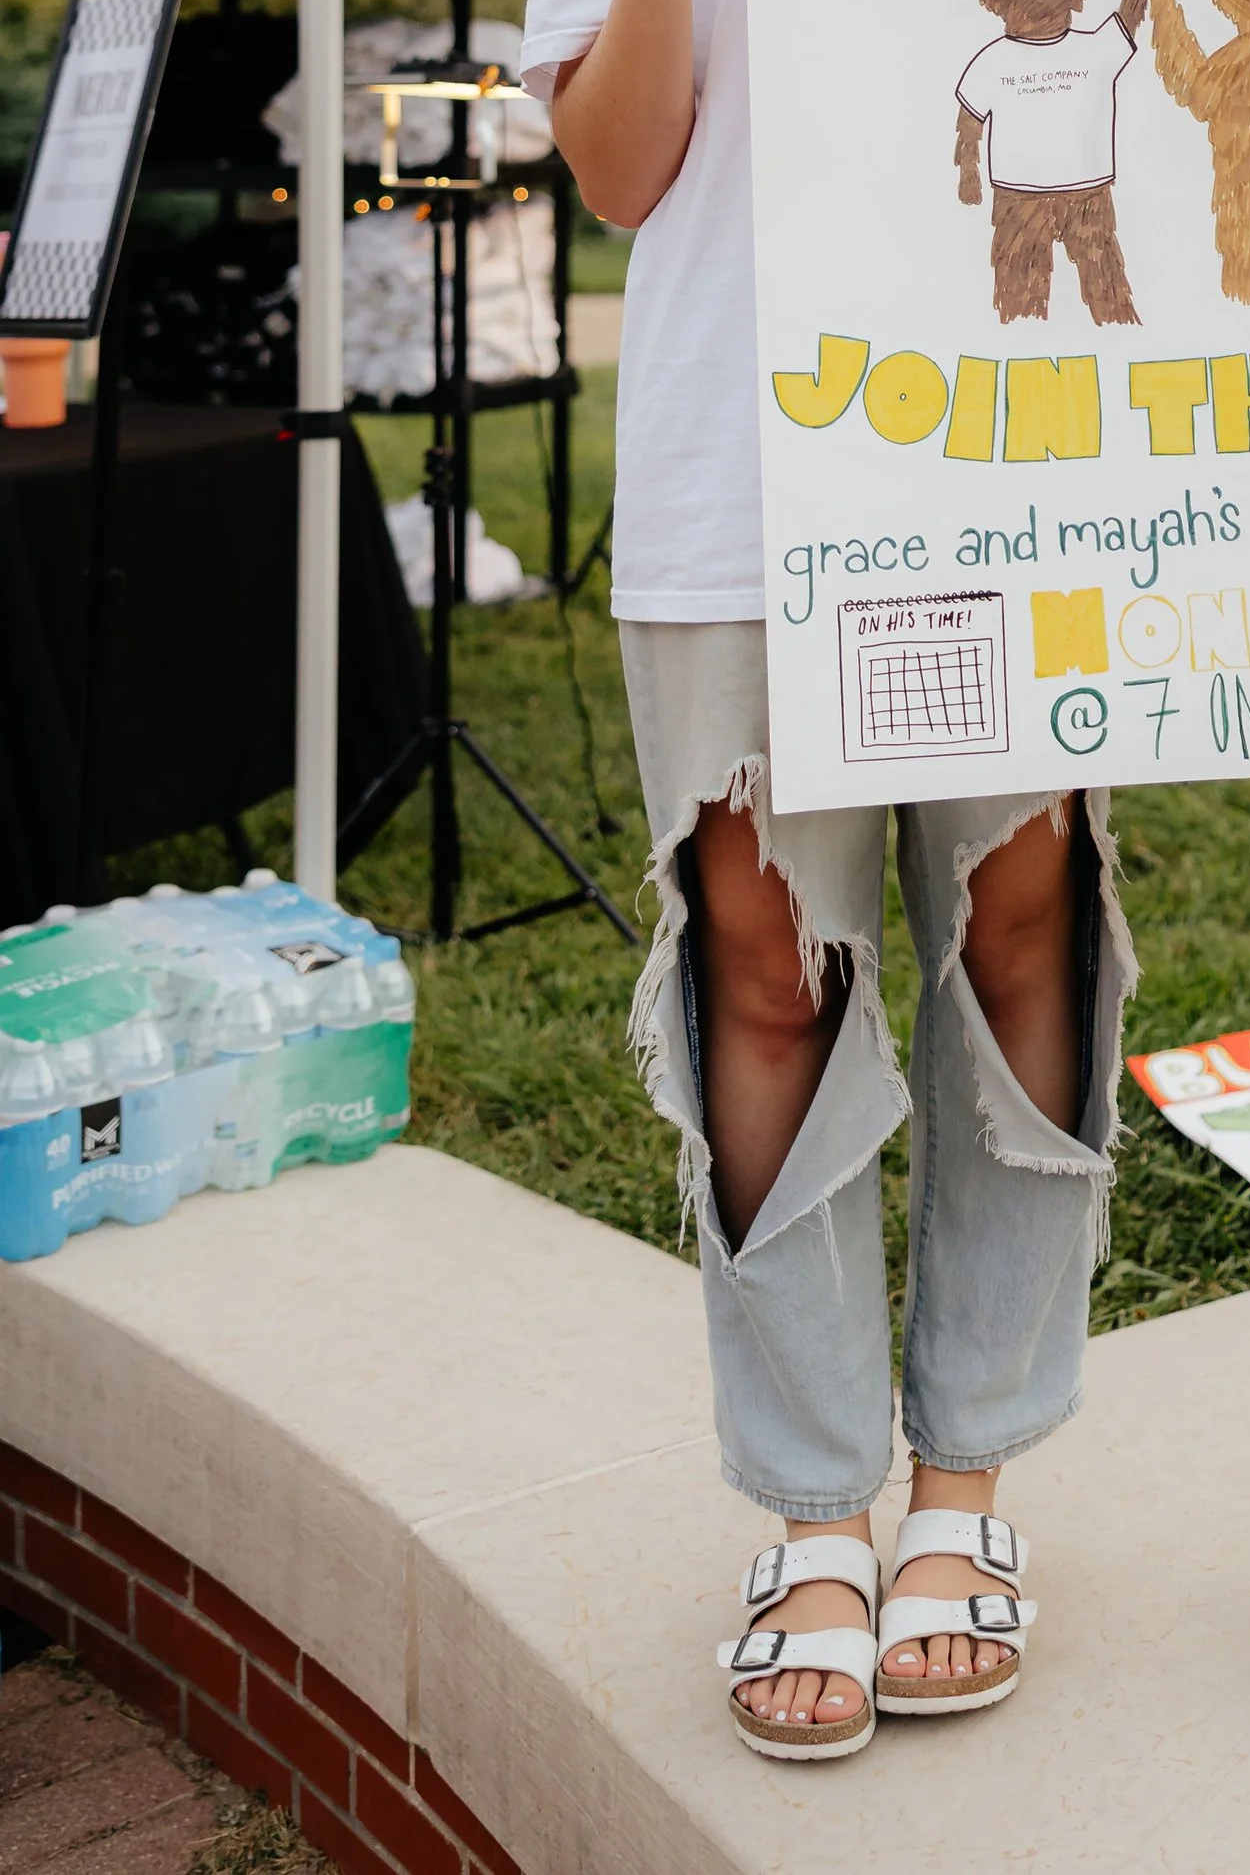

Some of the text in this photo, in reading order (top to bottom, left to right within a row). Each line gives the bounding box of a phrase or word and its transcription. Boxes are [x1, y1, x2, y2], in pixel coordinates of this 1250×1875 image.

[1000, 70, 1089, 86] THE SALT COMPANY
[772, 333, 1102, 463] JOIN
[784, 536, 929, 624] grace
[956, 505, 1038, 566] and
[1059, 486, 1241, 588] mayah's
[858, 609, 972, 636] ON HIS TIME!
